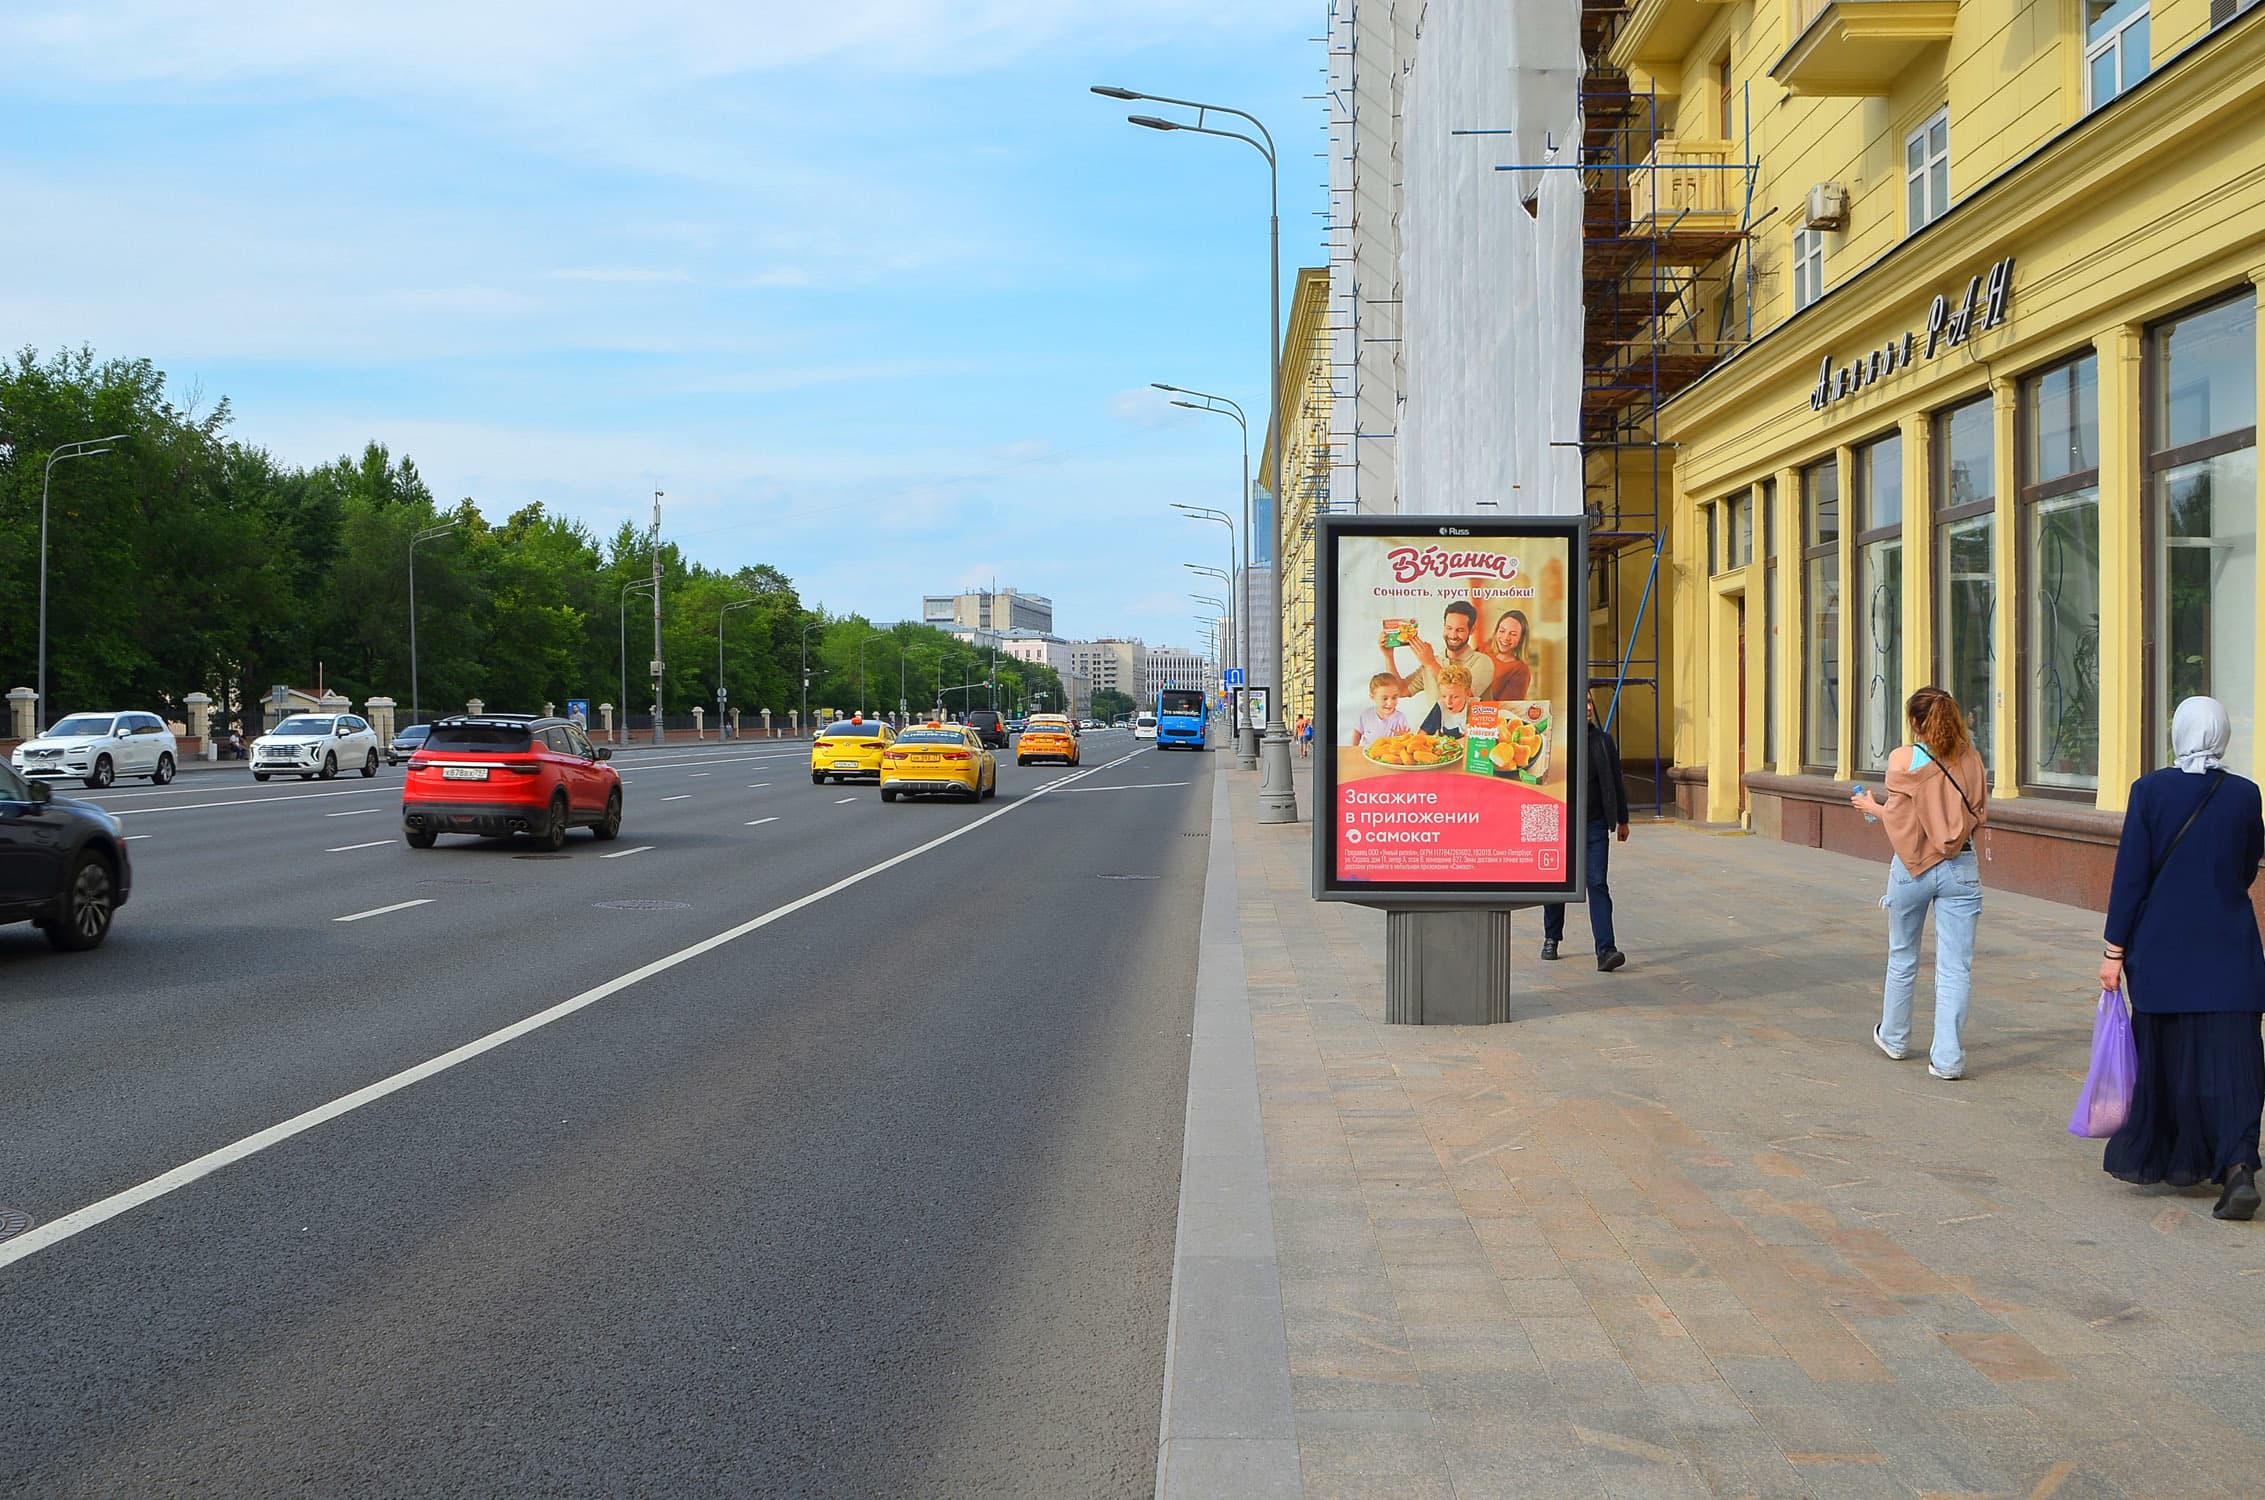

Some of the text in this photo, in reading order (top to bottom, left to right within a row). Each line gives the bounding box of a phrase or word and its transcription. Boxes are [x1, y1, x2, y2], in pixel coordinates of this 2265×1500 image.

[1923, 256, 2017, 360] РАН
[1448, 527, 1470, 536] Russ
[1387, 545, 1516, 583] Вязанка
[1373, 586, 1535, 599] Сочность, хруст и улыбки!
[1344, 788, 1438, 805] Закажите
[1345, 812, 1480, 828] в приложении
[1365, 830, 1441, 843] самокат
[1543, 852, 1555, 867] 6+
